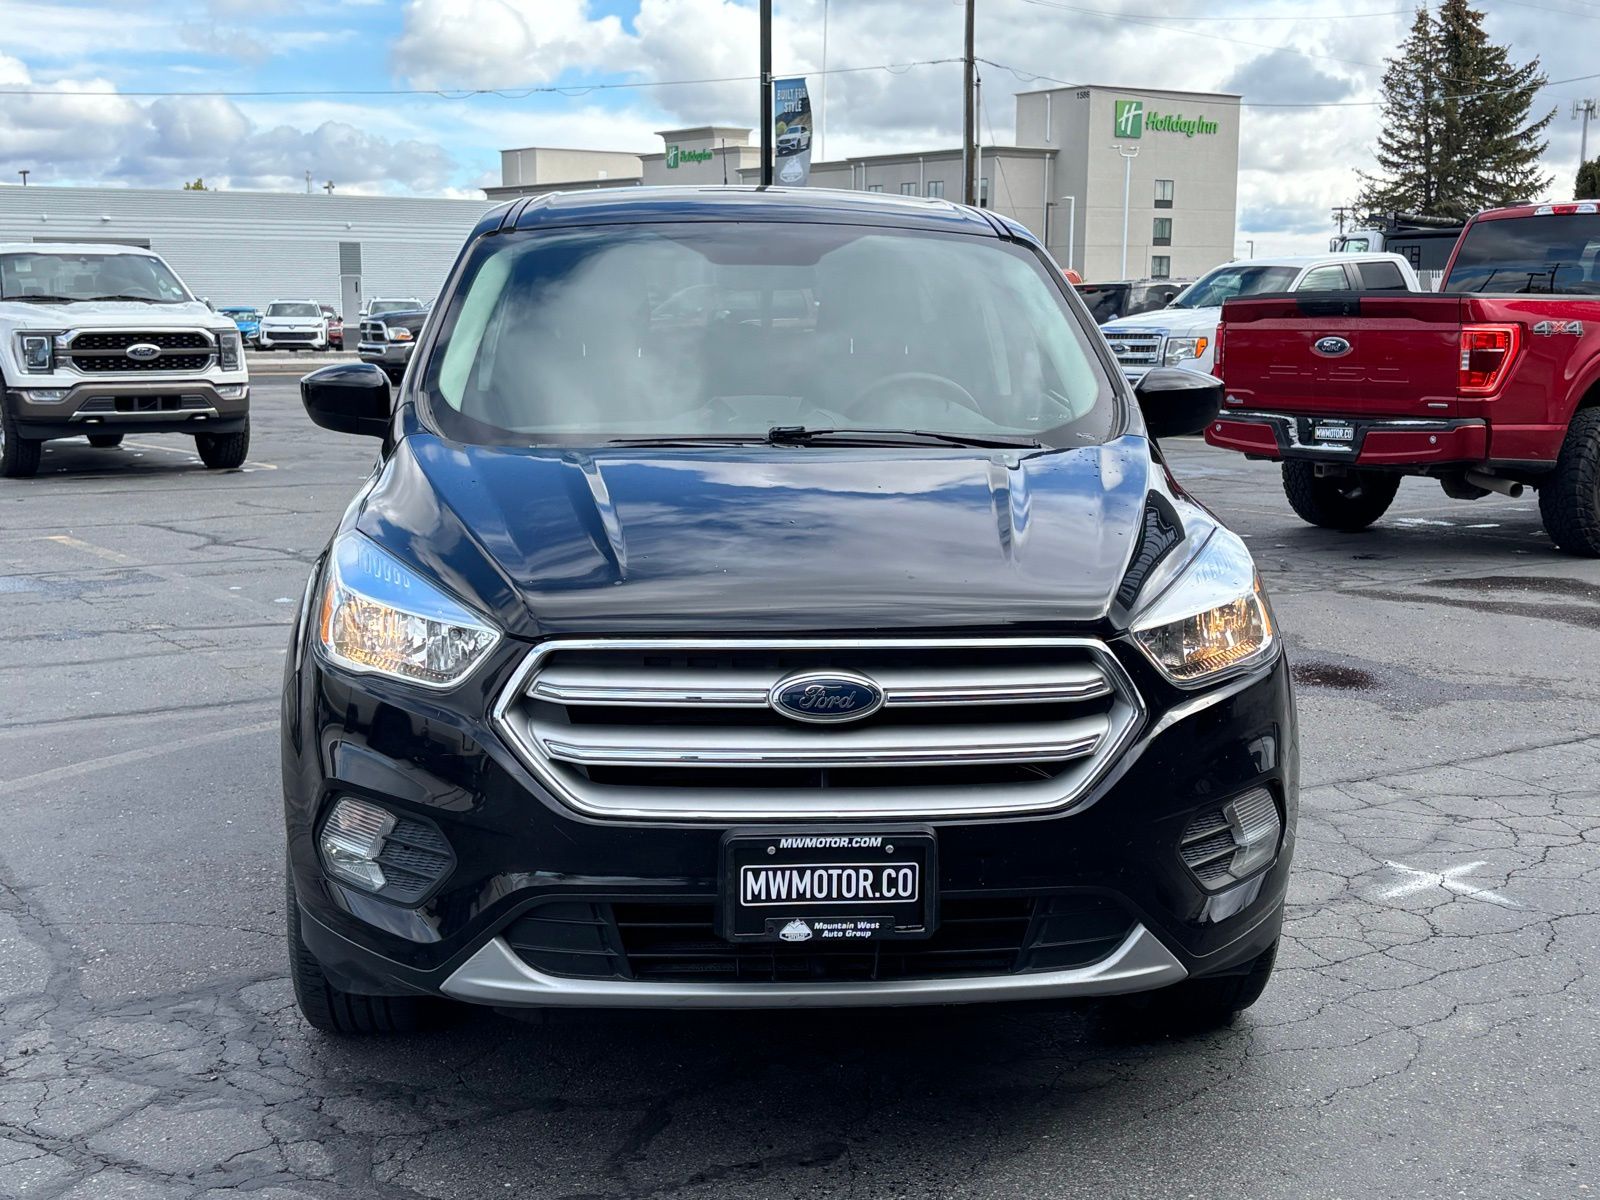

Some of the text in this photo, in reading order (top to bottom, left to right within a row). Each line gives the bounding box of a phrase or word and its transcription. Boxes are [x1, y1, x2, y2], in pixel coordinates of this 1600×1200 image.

[777, 88, 807, 100] BUILT FOR
[783, 101, 803, 113] STYLE
[1145, 111, 1218, 138] Holiday Inn
[1316, 428, 1352, 439] MWMOTOR.CO
[799, 684, 857, 709] Ford
[779, 837, 882, 849] MWMOTOR.COM
[746, 868, 913, 900] MWMOTOR.CO
[814, 921, 880, 930] Mountain West
[822, 930, 872, 938] Auto Group
